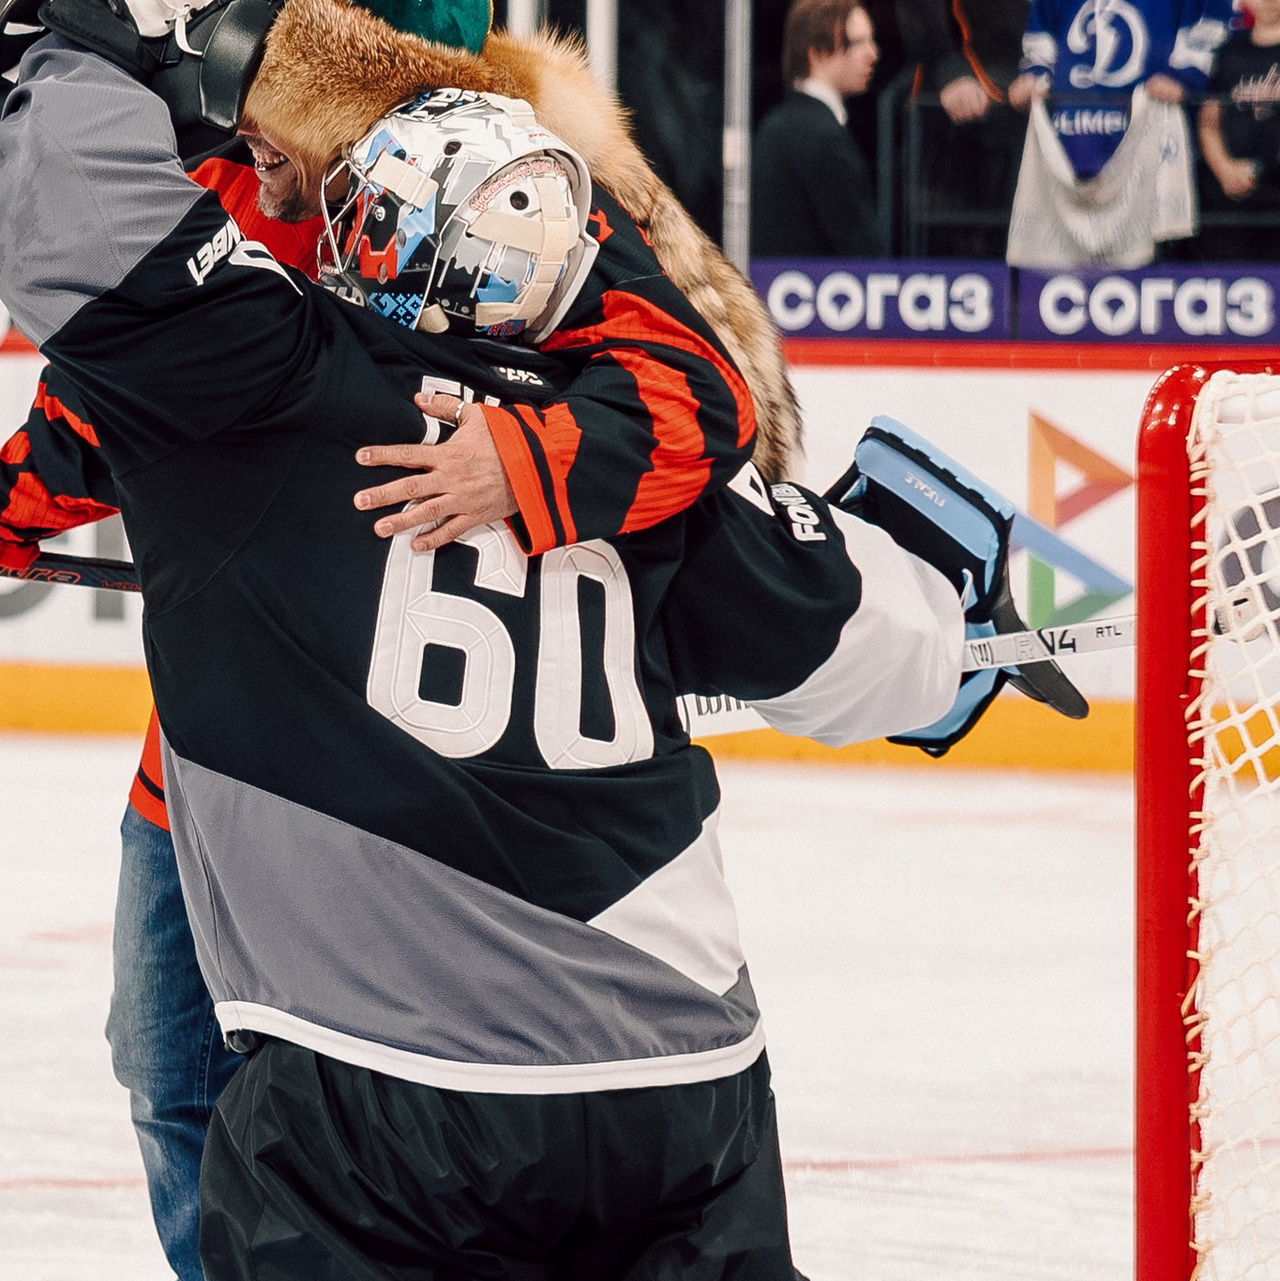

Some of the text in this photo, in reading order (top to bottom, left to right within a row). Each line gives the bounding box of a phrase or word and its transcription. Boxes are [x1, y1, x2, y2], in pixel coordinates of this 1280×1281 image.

[1053, 109, 1127, 136] LIMP
[366, 500, 655, 770] 60
[1095, 624, 1123, 639] RTL
